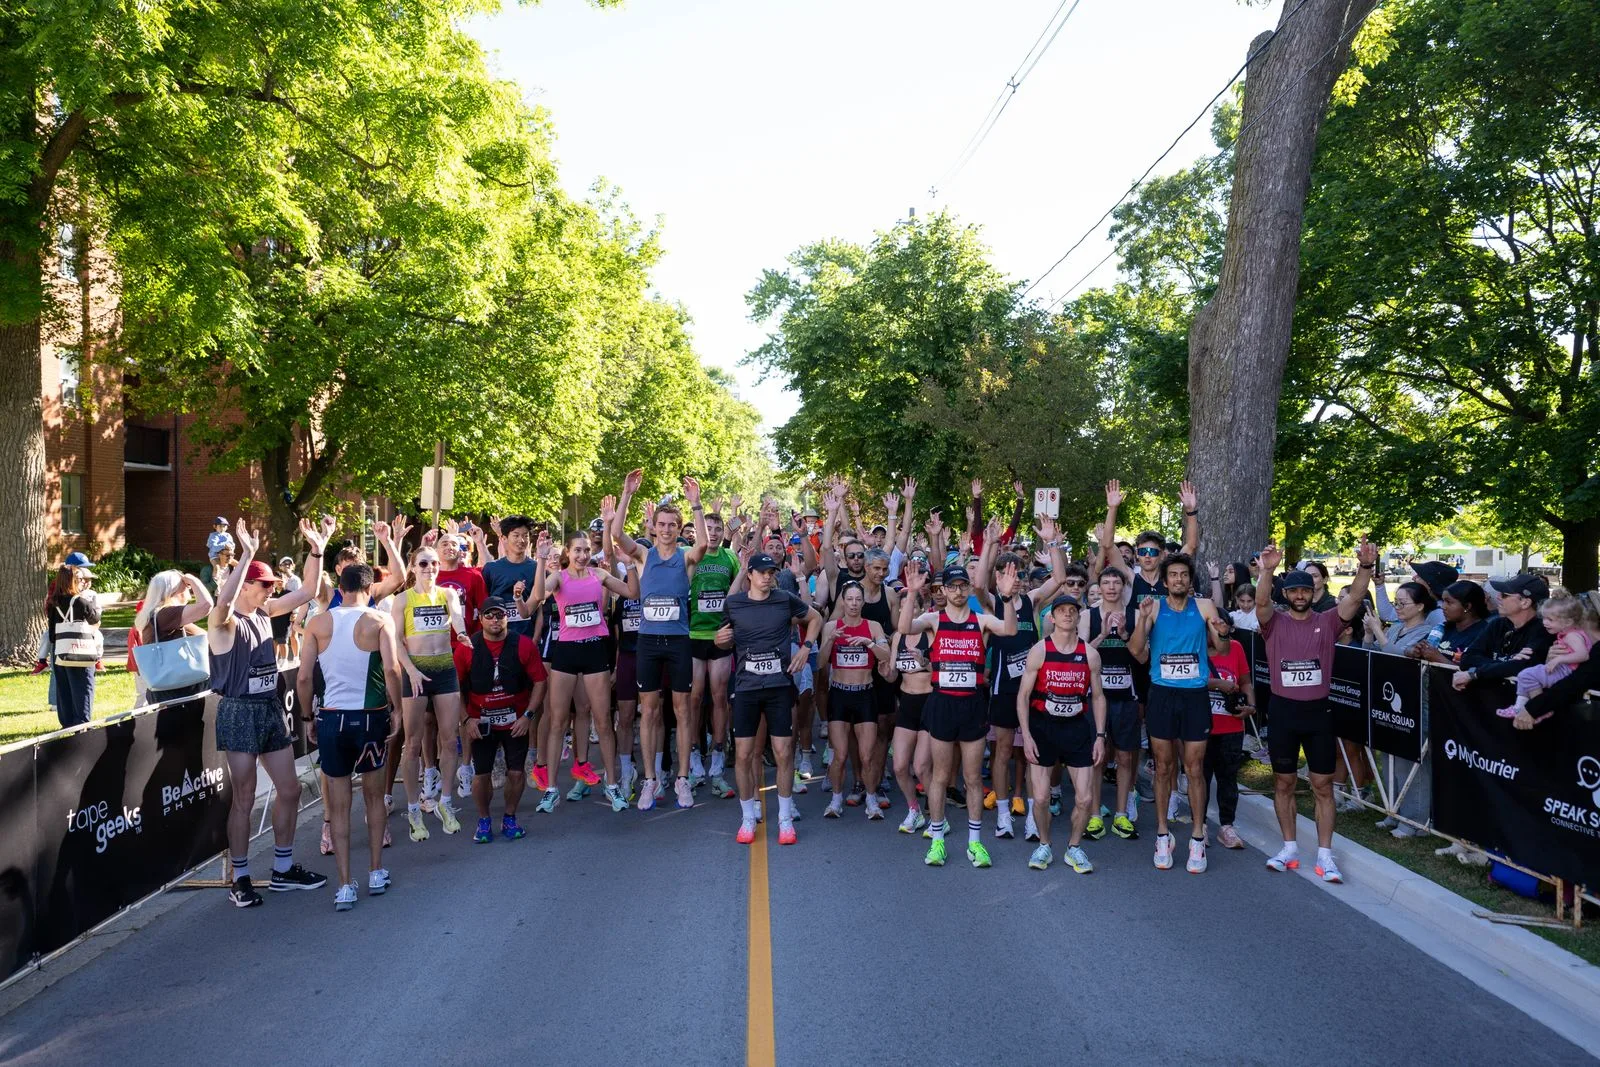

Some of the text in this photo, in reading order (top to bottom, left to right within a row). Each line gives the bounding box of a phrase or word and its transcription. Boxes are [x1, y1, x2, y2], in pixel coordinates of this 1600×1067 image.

[706, 600, 722, 609] 207
[652, 607, 671, 617] 707
[423, 615, 443, 626] 939
[574, 613, 593, 624] 706
[629, 619, 640, 627] 35
[944, 637, 974, 649] Running
[843, 653, 860, 662] 949
[754, 661, 773, 671] 498
[901, 660, 916, 670] 573
[1170, 664, 1191, 675] 745
[259, 674, 275, 688] 784
[948, 672, 968, 682] 275
[1050, 670, 1082, 681] Running
[1104, 675, 1124, 685] 402
[1290, 671, 1313, 682] 702
[831, 681, 867, 691] UNDER
[1054, 704, 1073, 713] 626
[489, 715, 508, 724] 895
[1371, 709, 1415, 728] SPEAK SQUAD
[1458, 744, 1520, 780] MyCourier
[163, 782, 224, 816] PHYSIO
[1543, 797, 1587, 825] SPEAK
[66, 801, 109, 833] tape
[96, 806, 142, 853] geeks
[1551, 816, 1595, 837] CONNECTIVE
